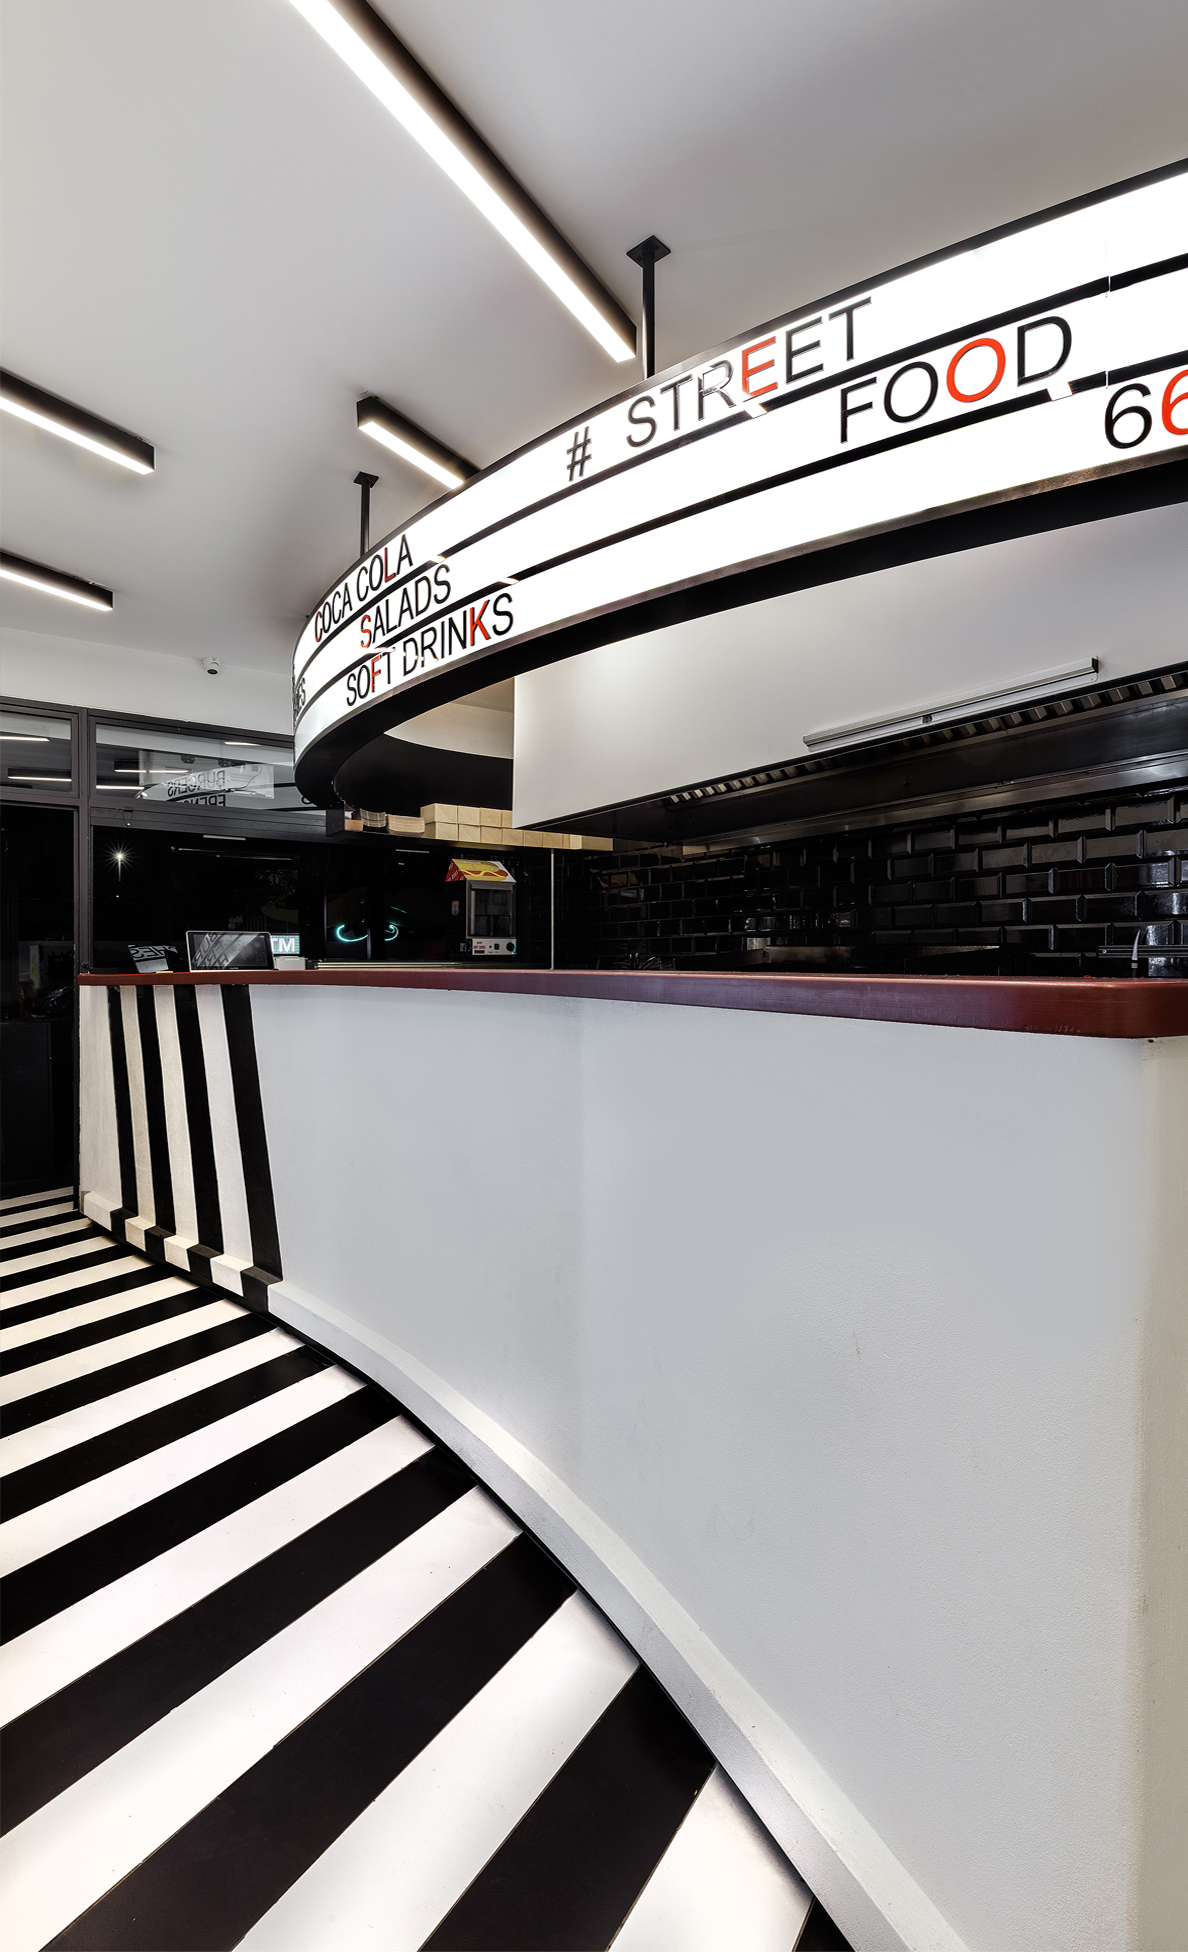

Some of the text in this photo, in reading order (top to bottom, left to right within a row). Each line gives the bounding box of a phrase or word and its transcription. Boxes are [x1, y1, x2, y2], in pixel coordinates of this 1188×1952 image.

[625, 296, 872, 448] STREET
[840, 316, 1072, 443] FOOD
[314, 534, 414, 643] COCA COLA
[360, 564, 451, 649] SALADS
[346, 651, 393, 707] SOFT
[402, 592, 514, 677] DRINKS
